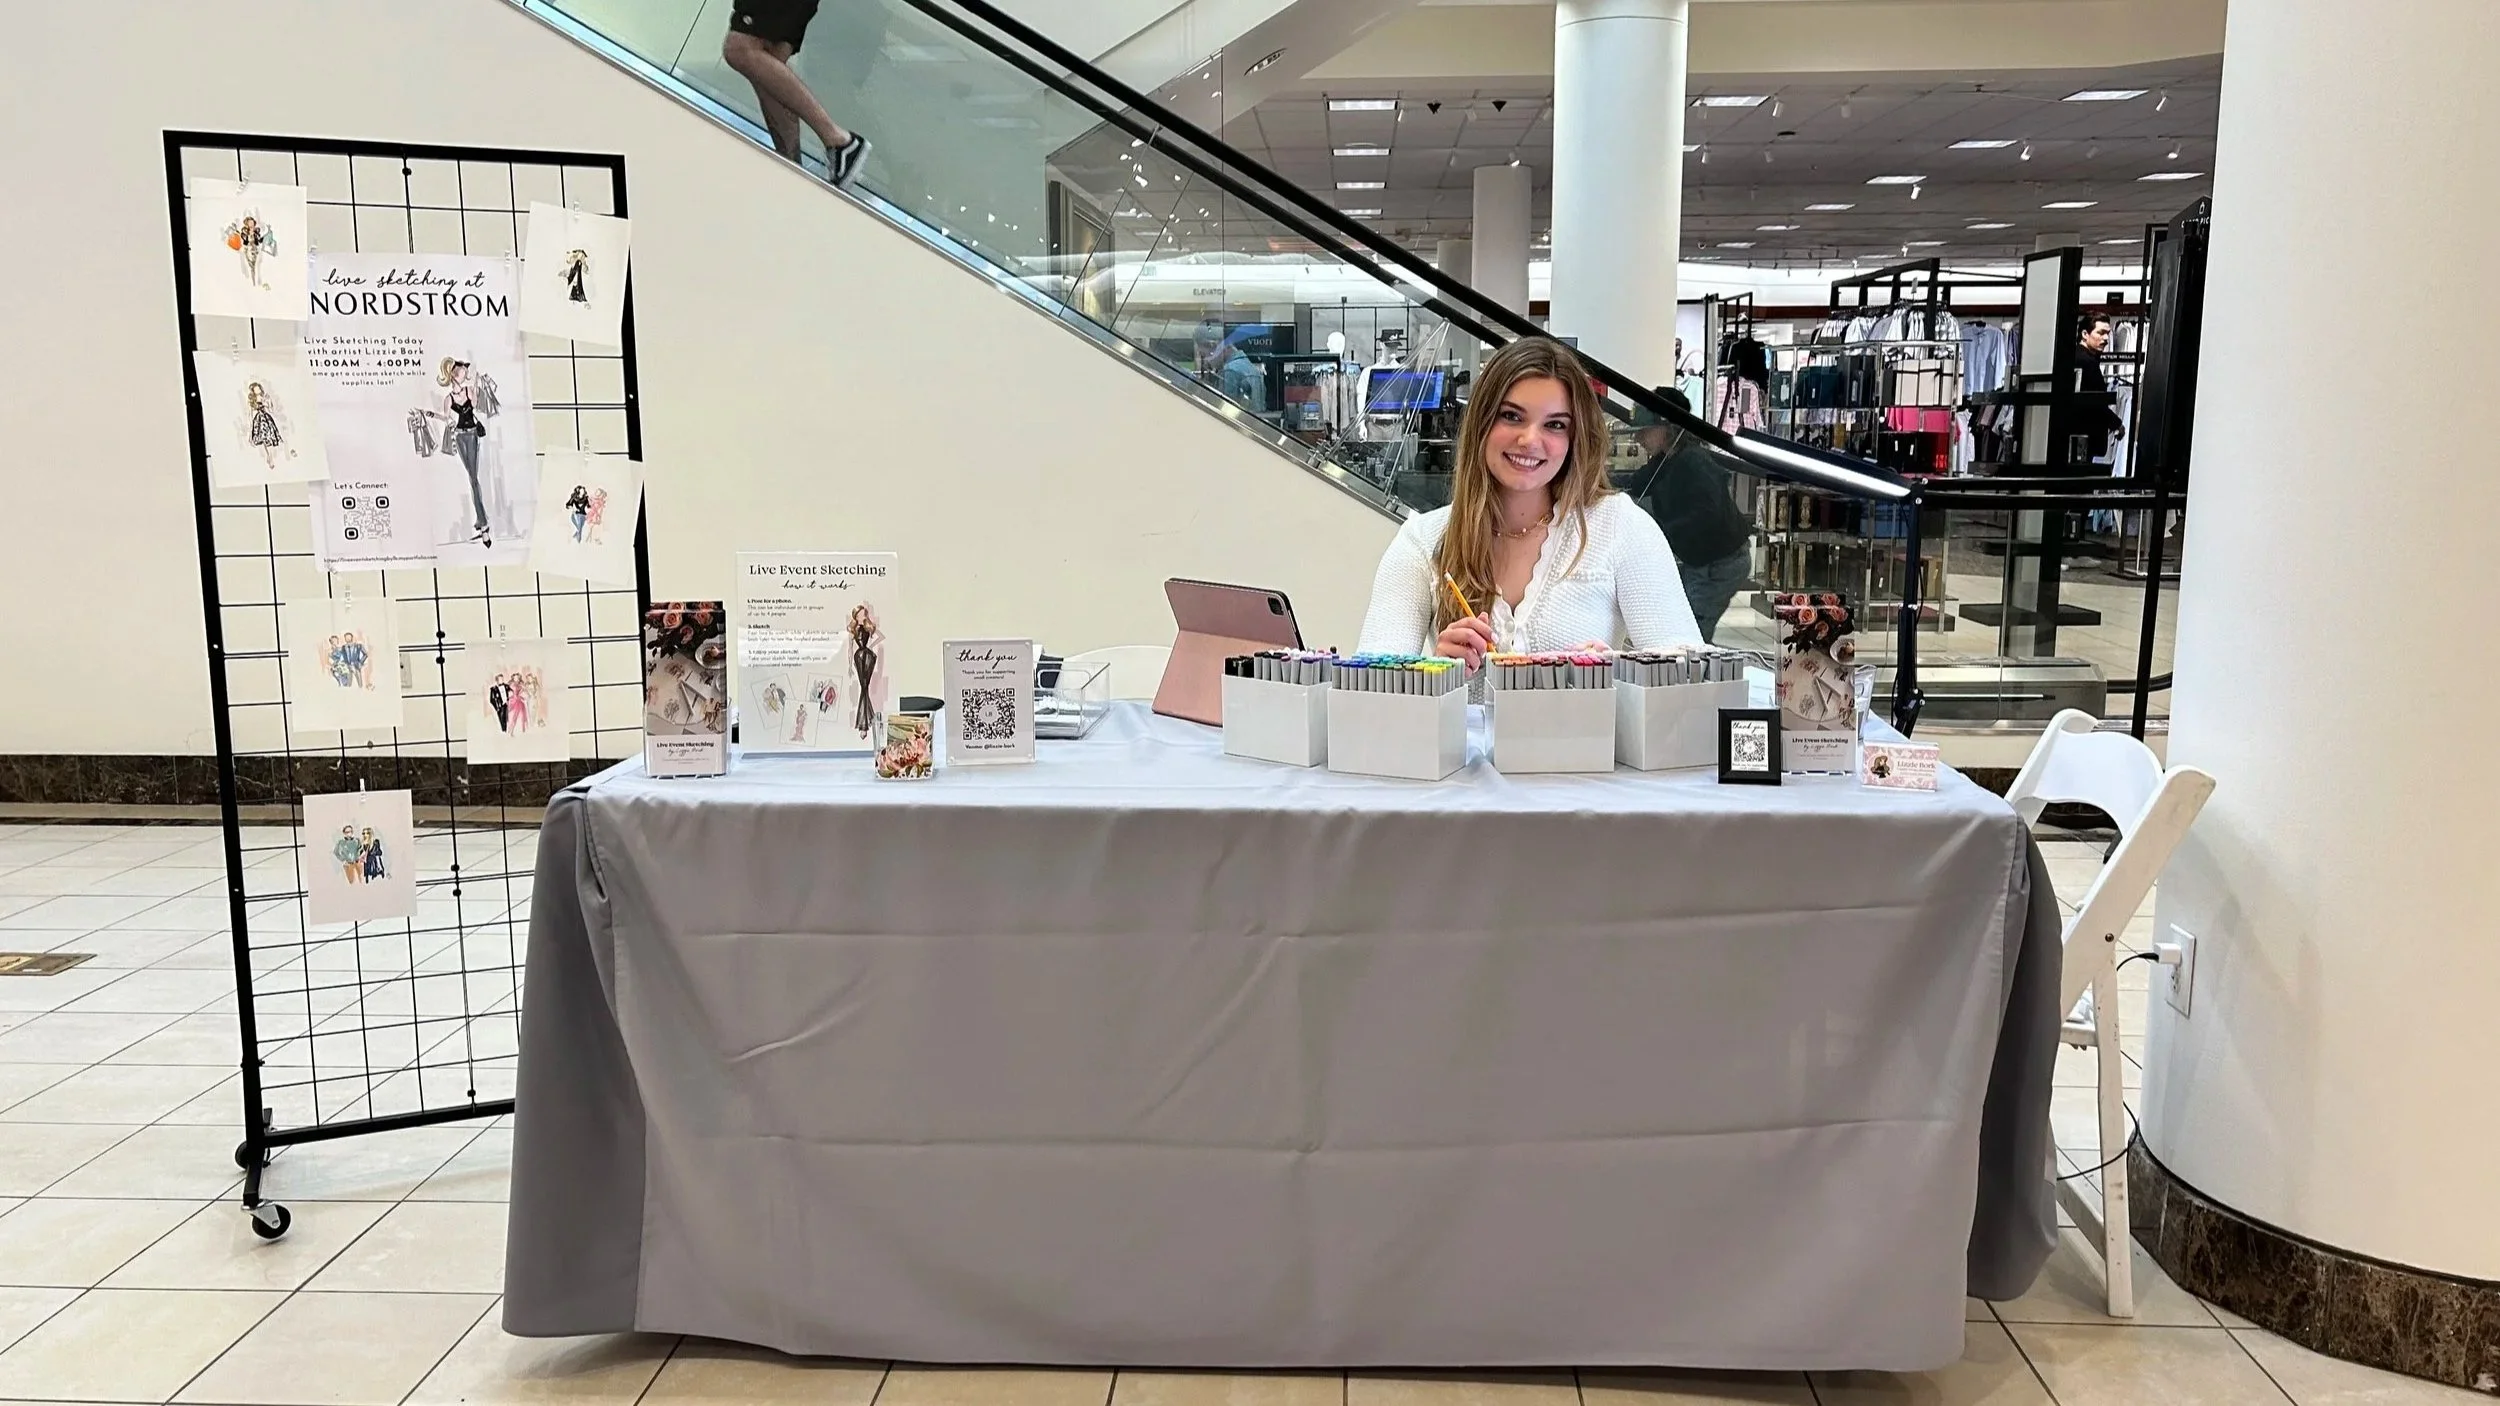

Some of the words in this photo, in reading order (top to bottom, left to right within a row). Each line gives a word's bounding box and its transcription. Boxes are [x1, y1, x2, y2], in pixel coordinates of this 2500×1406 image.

[322, 268, 366, 287] live
[376, 268, 458, 295] sketching
[464, 271, 486, 288] at
[310, 291, 509, 317] NORDSTROM
[303, 336, 327, 344] Live
[333, 336, 386, 345] Sketching
[392, 336, 423, 345] Today
[1247, 338, 1273, 346] vuori
[365, 347, 397, 355] Lizzie
[309, 359, 360, 367] 11:00AM
[376, 359, 421, 367] 4:00PM
[355, 481, 389, 489] Connect:
[749, 564, 777, 575] Live
[780, 564, 818, 575] Event
[820, 564, 886, 577] Sketching
[781, 579, 804, 589] how
[806, 579, 817, 589] it
[818, 579, 855, 590] works
[955, 648, 994, 662] thank
[992, 655, 1018, 670] you
[1752, 726, 1765, 734] you
